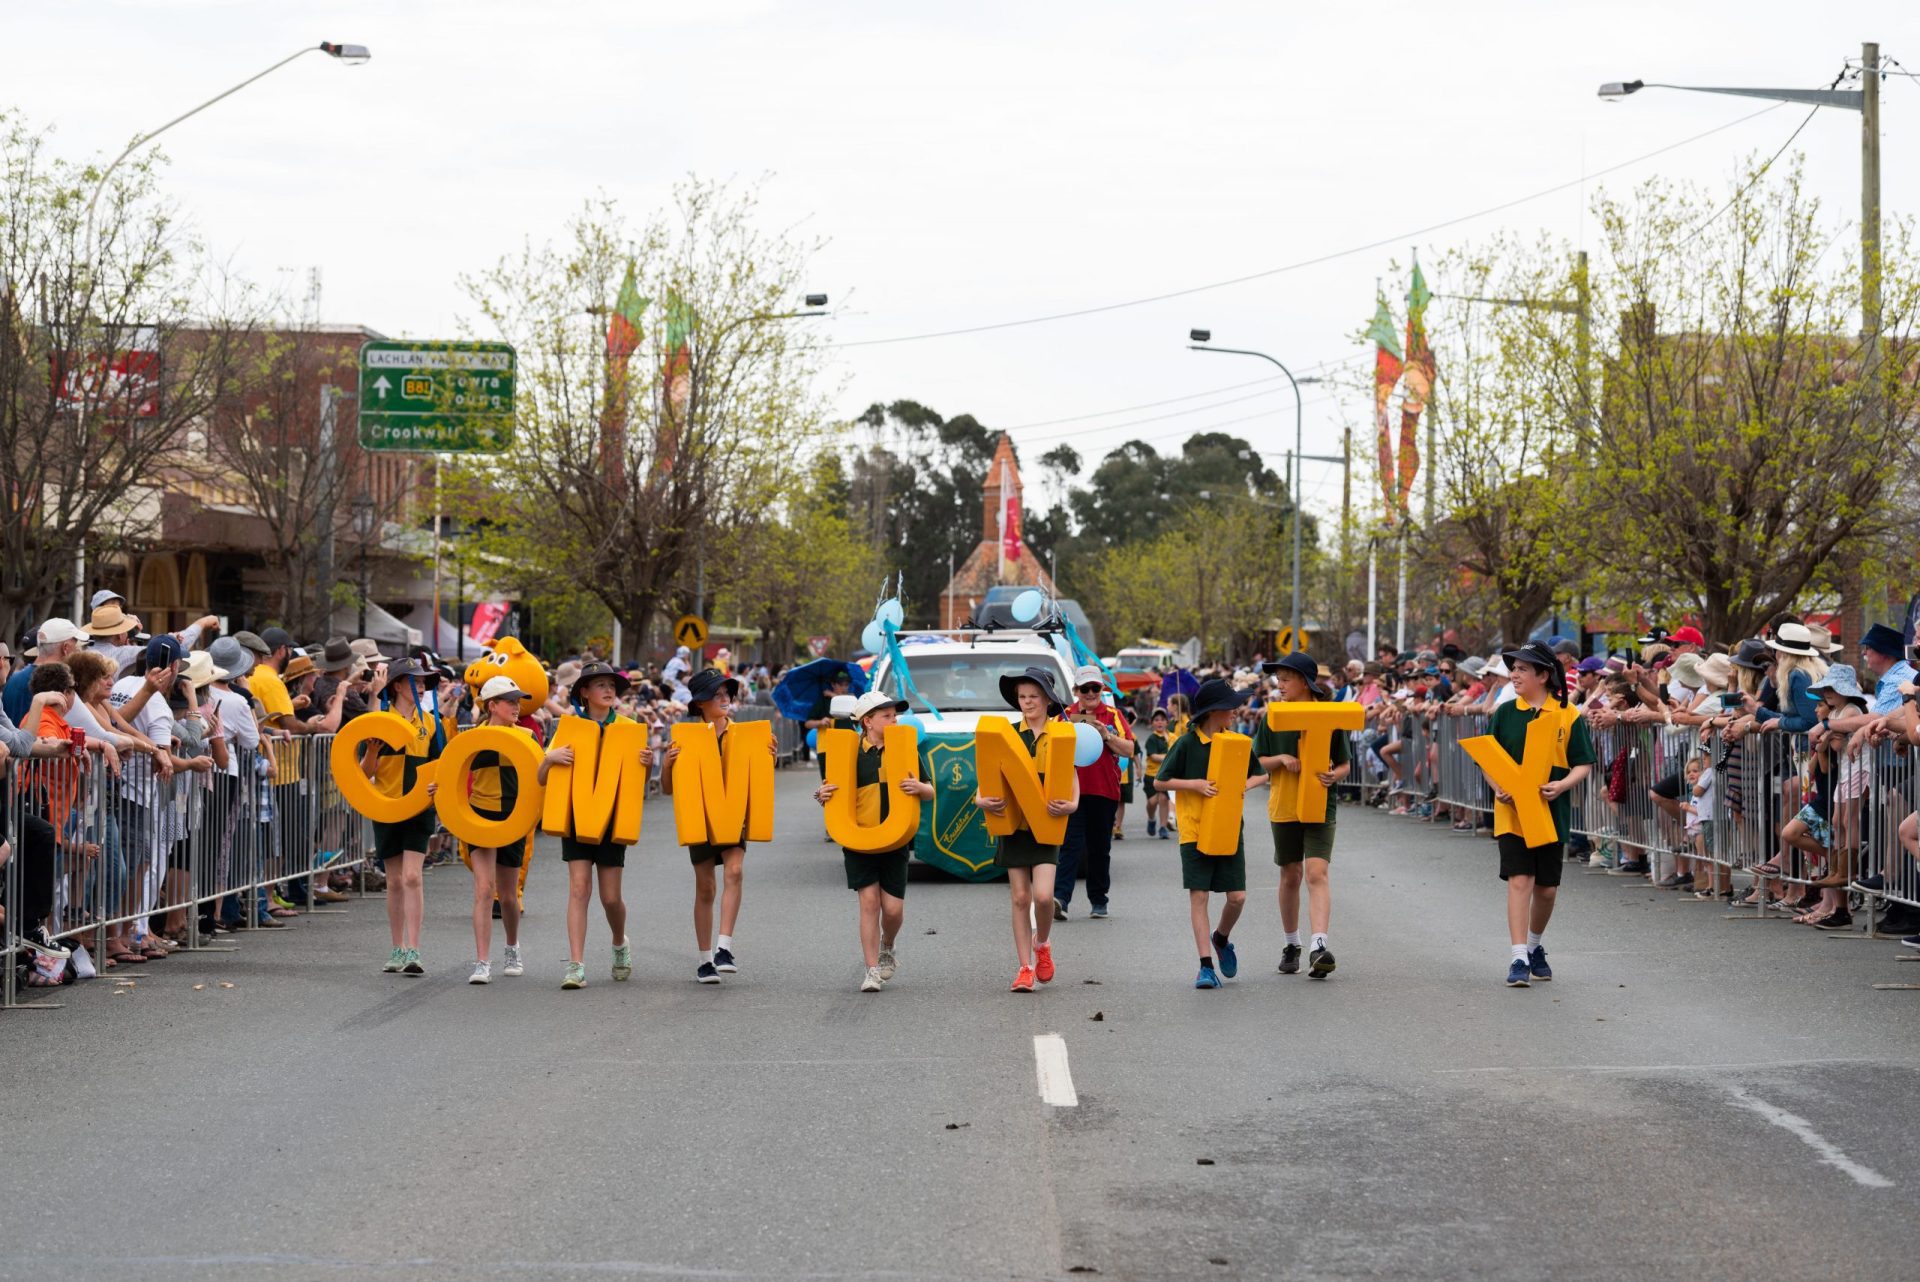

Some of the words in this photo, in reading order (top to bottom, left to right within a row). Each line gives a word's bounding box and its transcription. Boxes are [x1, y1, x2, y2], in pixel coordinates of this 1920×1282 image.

[369, 353, 423, 365] LACHLAN
[431, 354, 474, 365] VALY
[331, 701, 1562, 855] COMMUNITY
